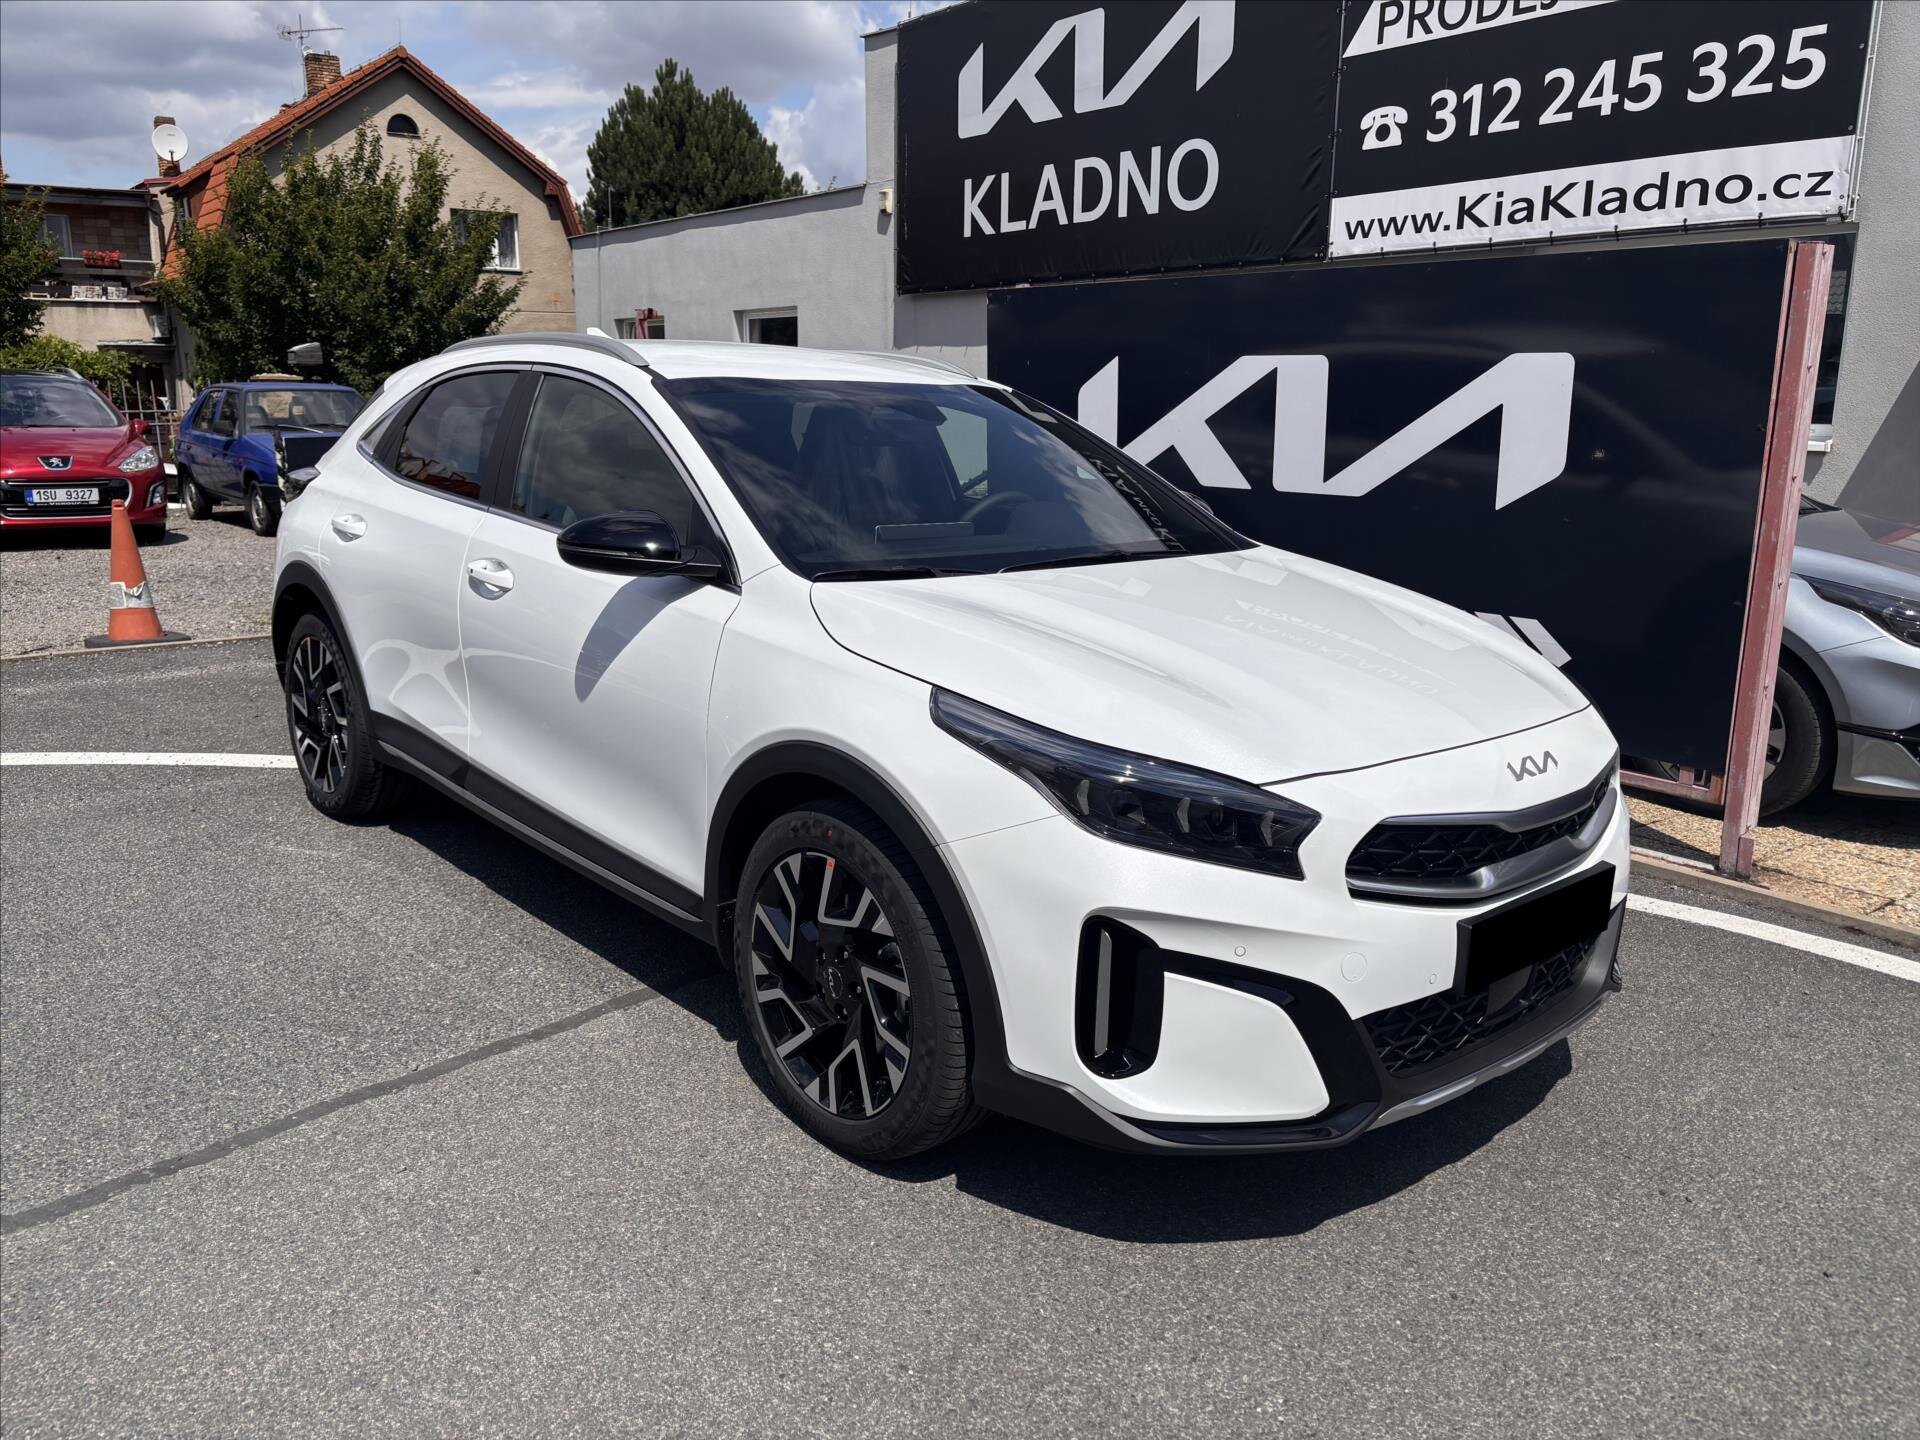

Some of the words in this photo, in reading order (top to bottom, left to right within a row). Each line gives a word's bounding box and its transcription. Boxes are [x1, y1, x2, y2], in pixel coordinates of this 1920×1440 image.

[1377, 0, 1559, 45] PROD
[958, 0, 1236, 139] KIA
[1426, 77, 1522, 143] 312
[1538, 51, 1664, 126] 245
[1686, 23, 1828, 103] 325
[963, 138, 1220, 238] KLADNO
[1344, 170, 1834, 241] www.KiaKladno.cz
[1078, 352, 1576, 511] KIA
[35, 490, 57, 500] 1SU
[65, 489, 94, 500] 9327
[1506, 750, 1559, 782] KIA
